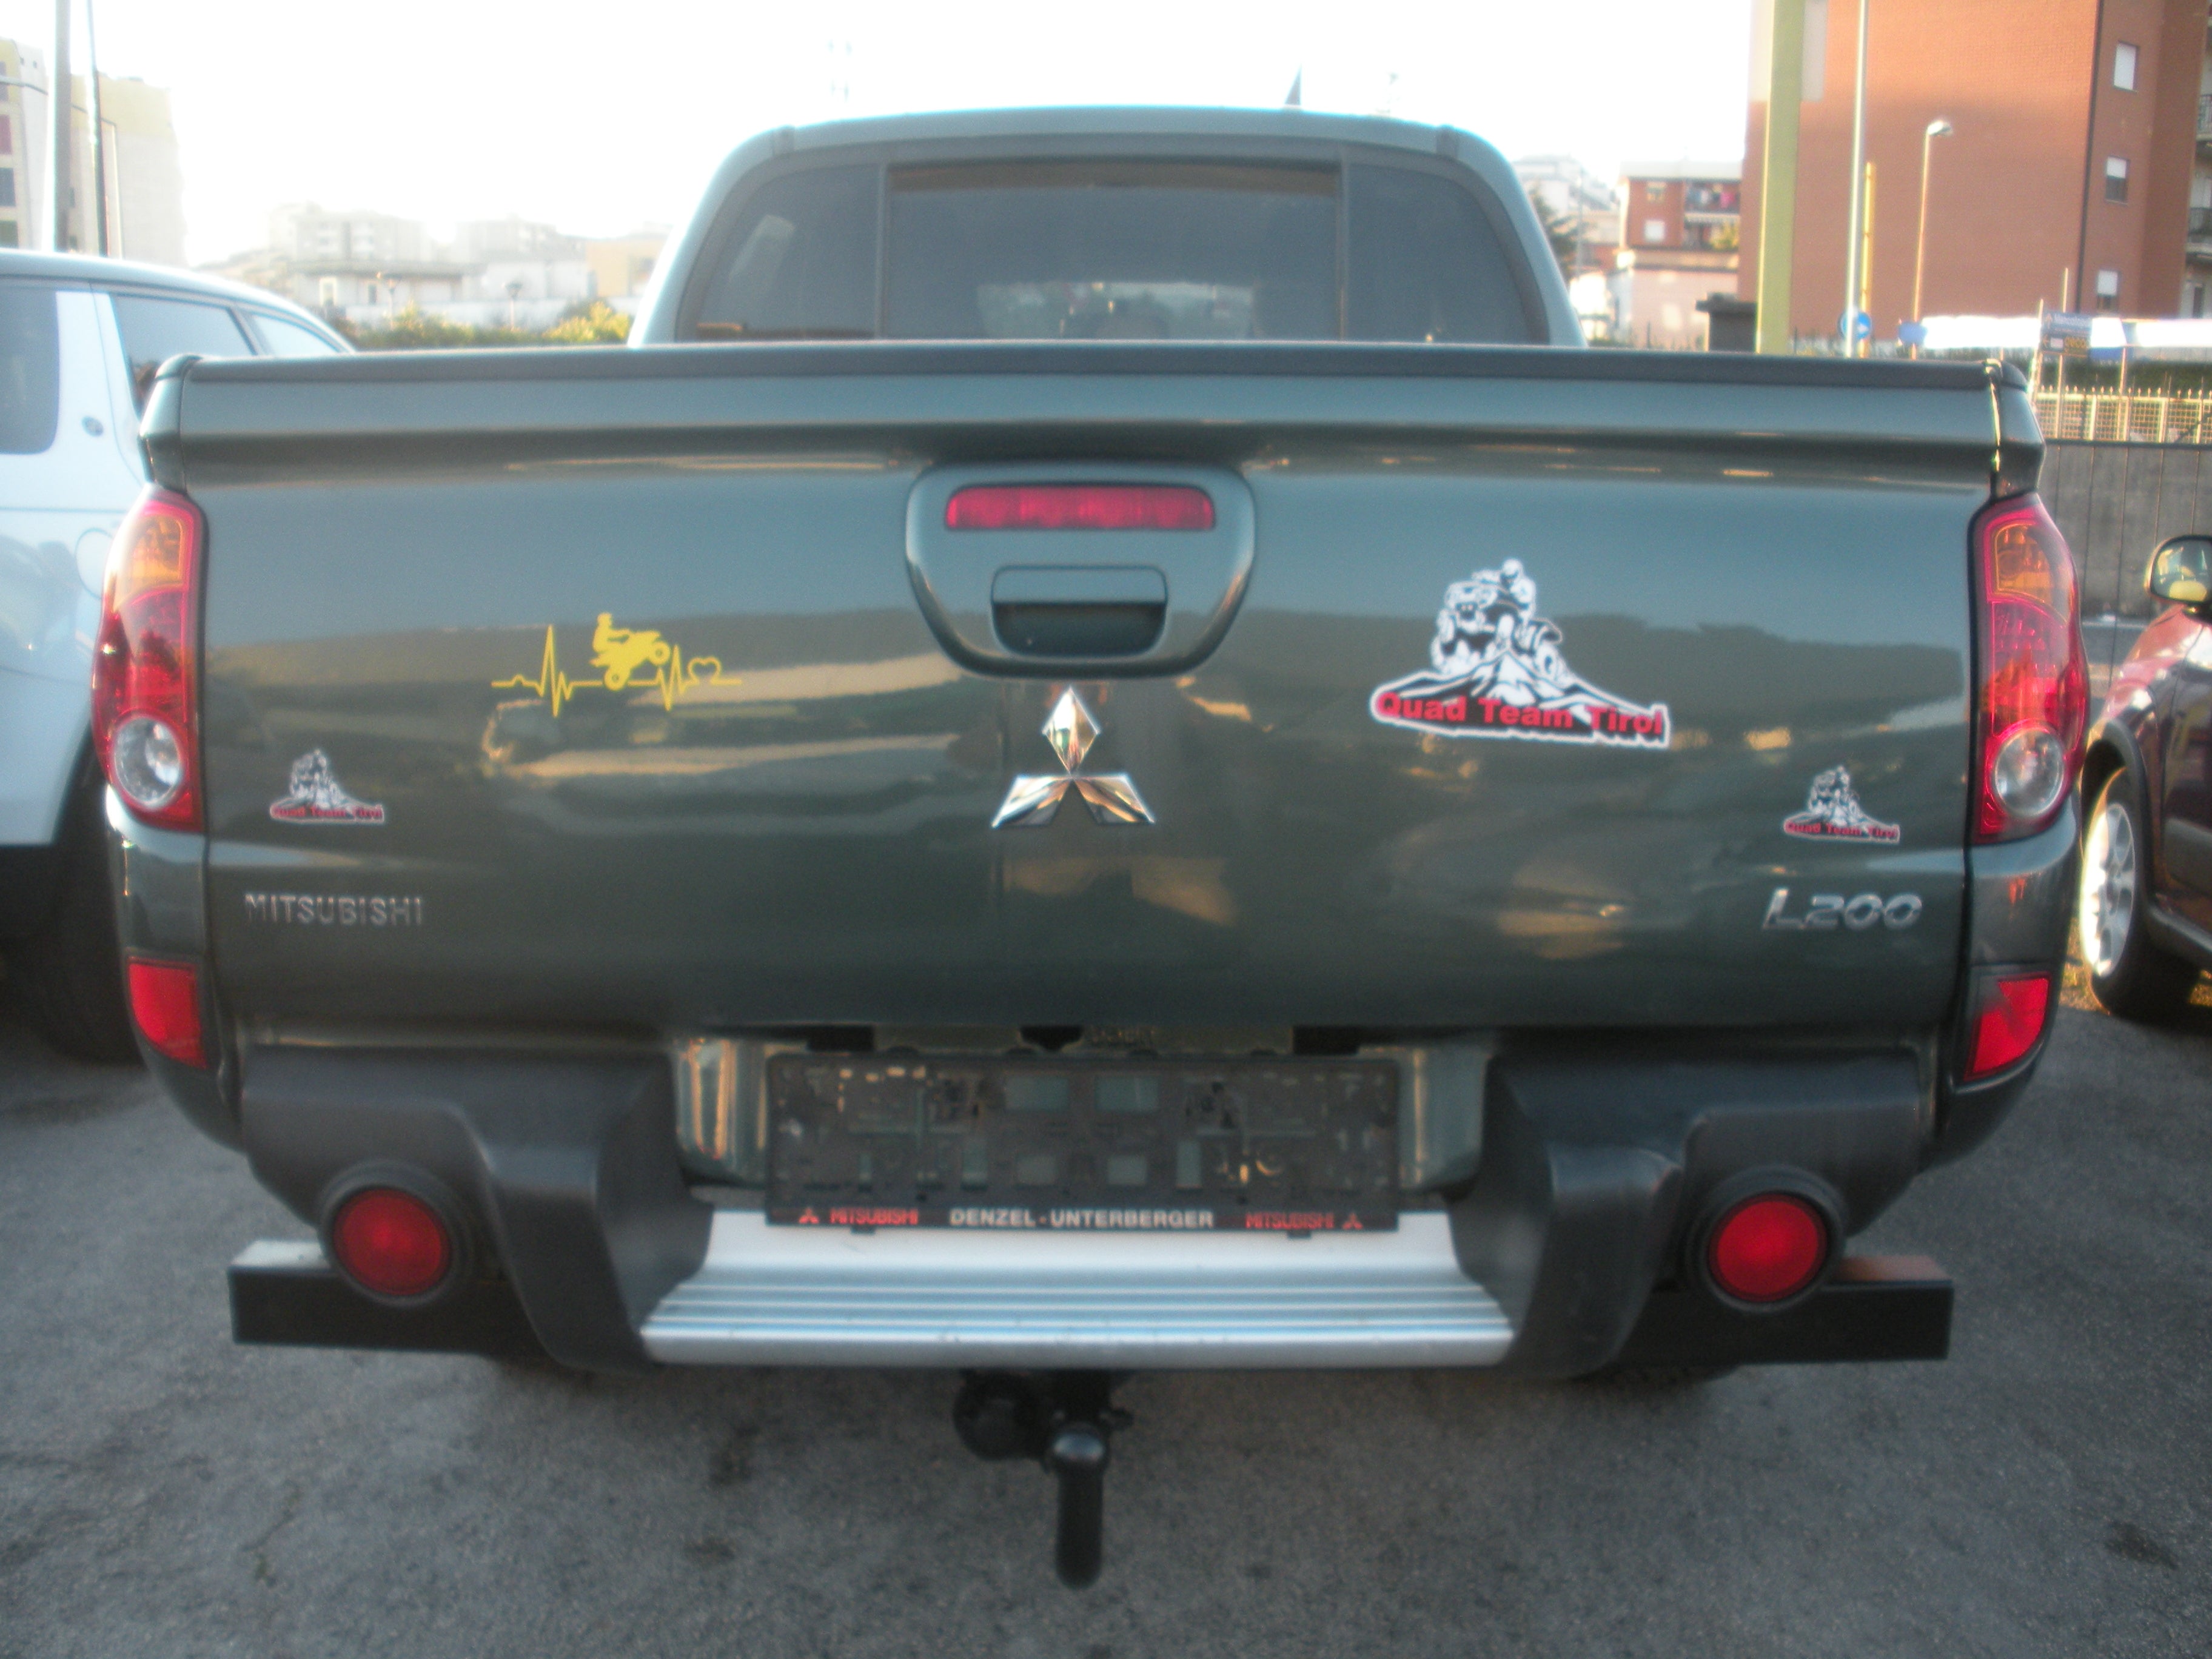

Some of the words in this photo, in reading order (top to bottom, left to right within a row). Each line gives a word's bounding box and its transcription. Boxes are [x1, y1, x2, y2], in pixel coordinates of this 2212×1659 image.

[1376, 692, 1467, 722] Quad
[1478, 698, 1573, 728] Team
[1586, 706, 1663, 734] Tirol
[244, 894, 422, 925] MITSUBISHI
[1761, 888, 1923, 930] L200
[830, 1208, 919, 1225] MITSUBISHI
[1245, 1212, 1334, 1230] MITSUBISHI
